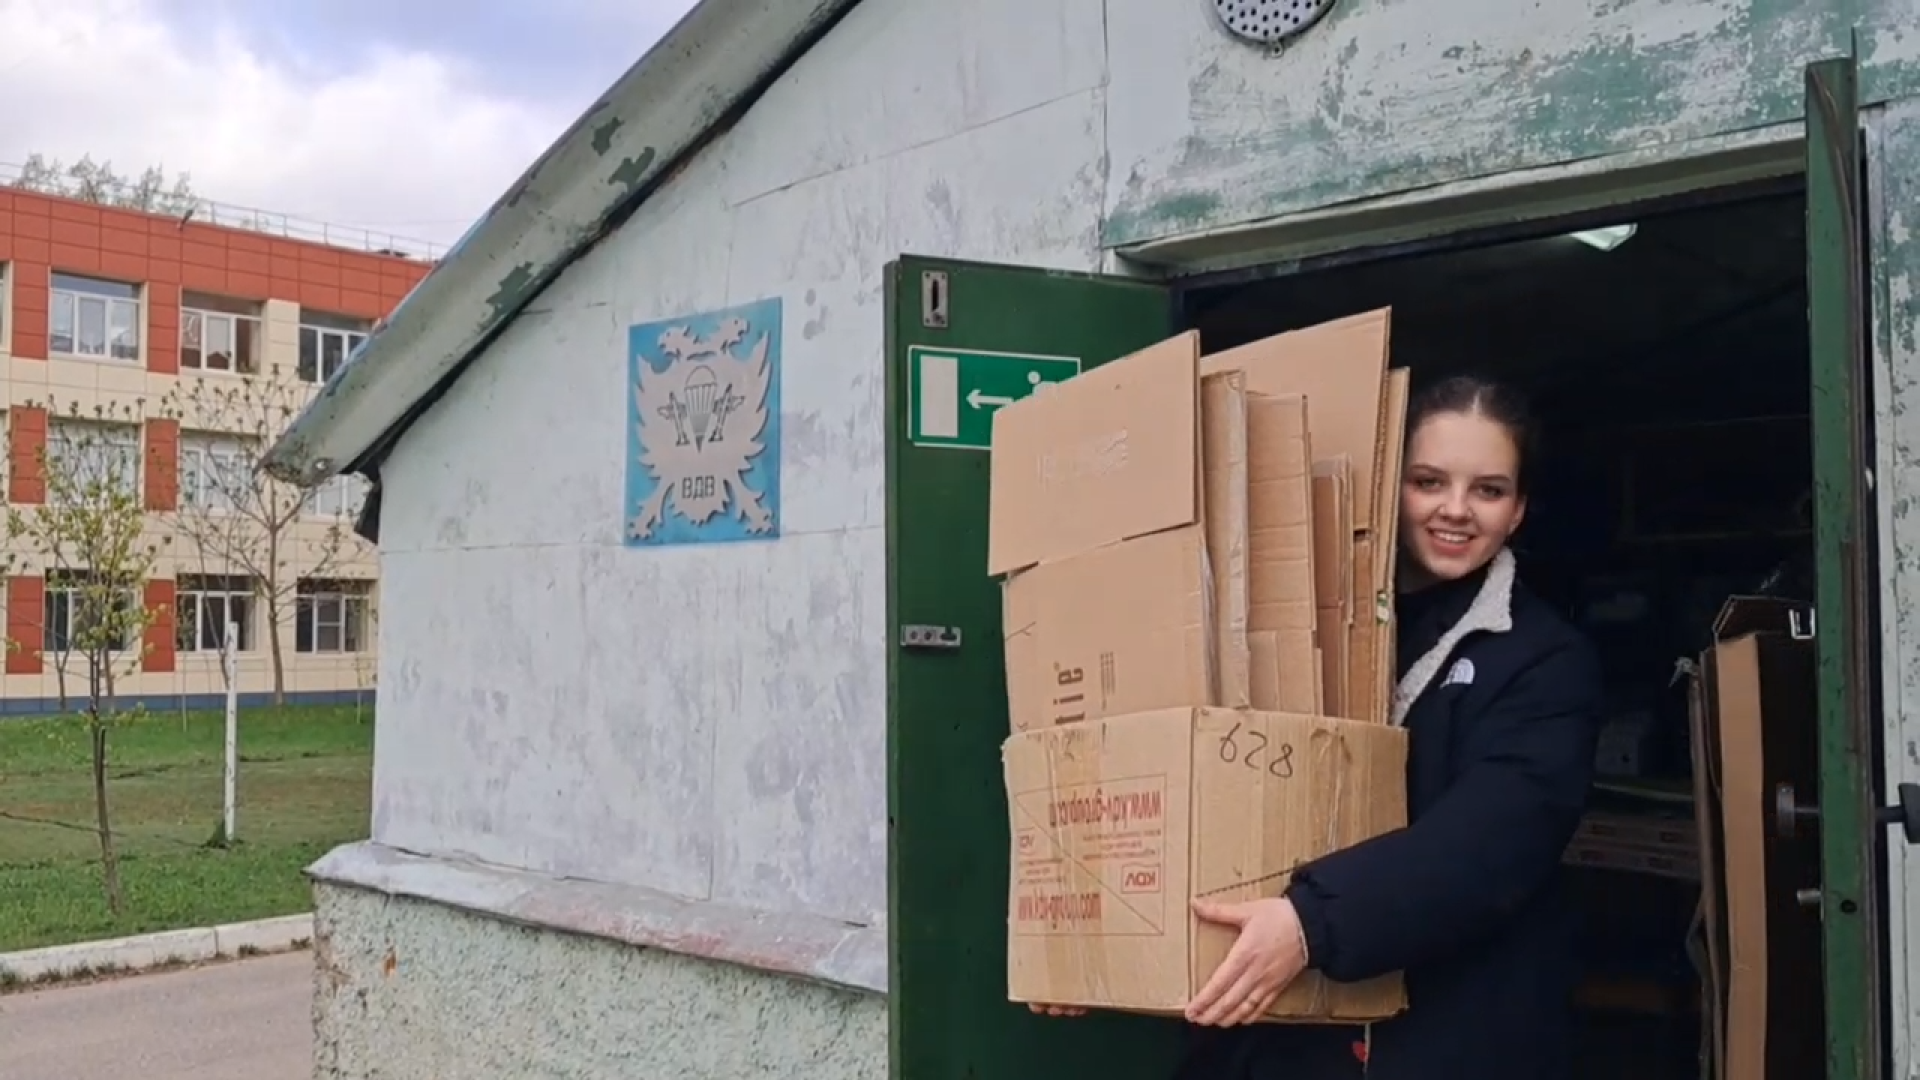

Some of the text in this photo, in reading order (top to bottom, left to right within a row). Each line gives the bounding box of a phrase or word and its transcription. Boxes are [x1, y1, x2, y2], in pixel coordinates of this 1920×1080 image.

[682, 475, 715, 500] ВДВ
[1220, 722, 1293, 777] 628
[1125, 871, 1156, 887] KDV
